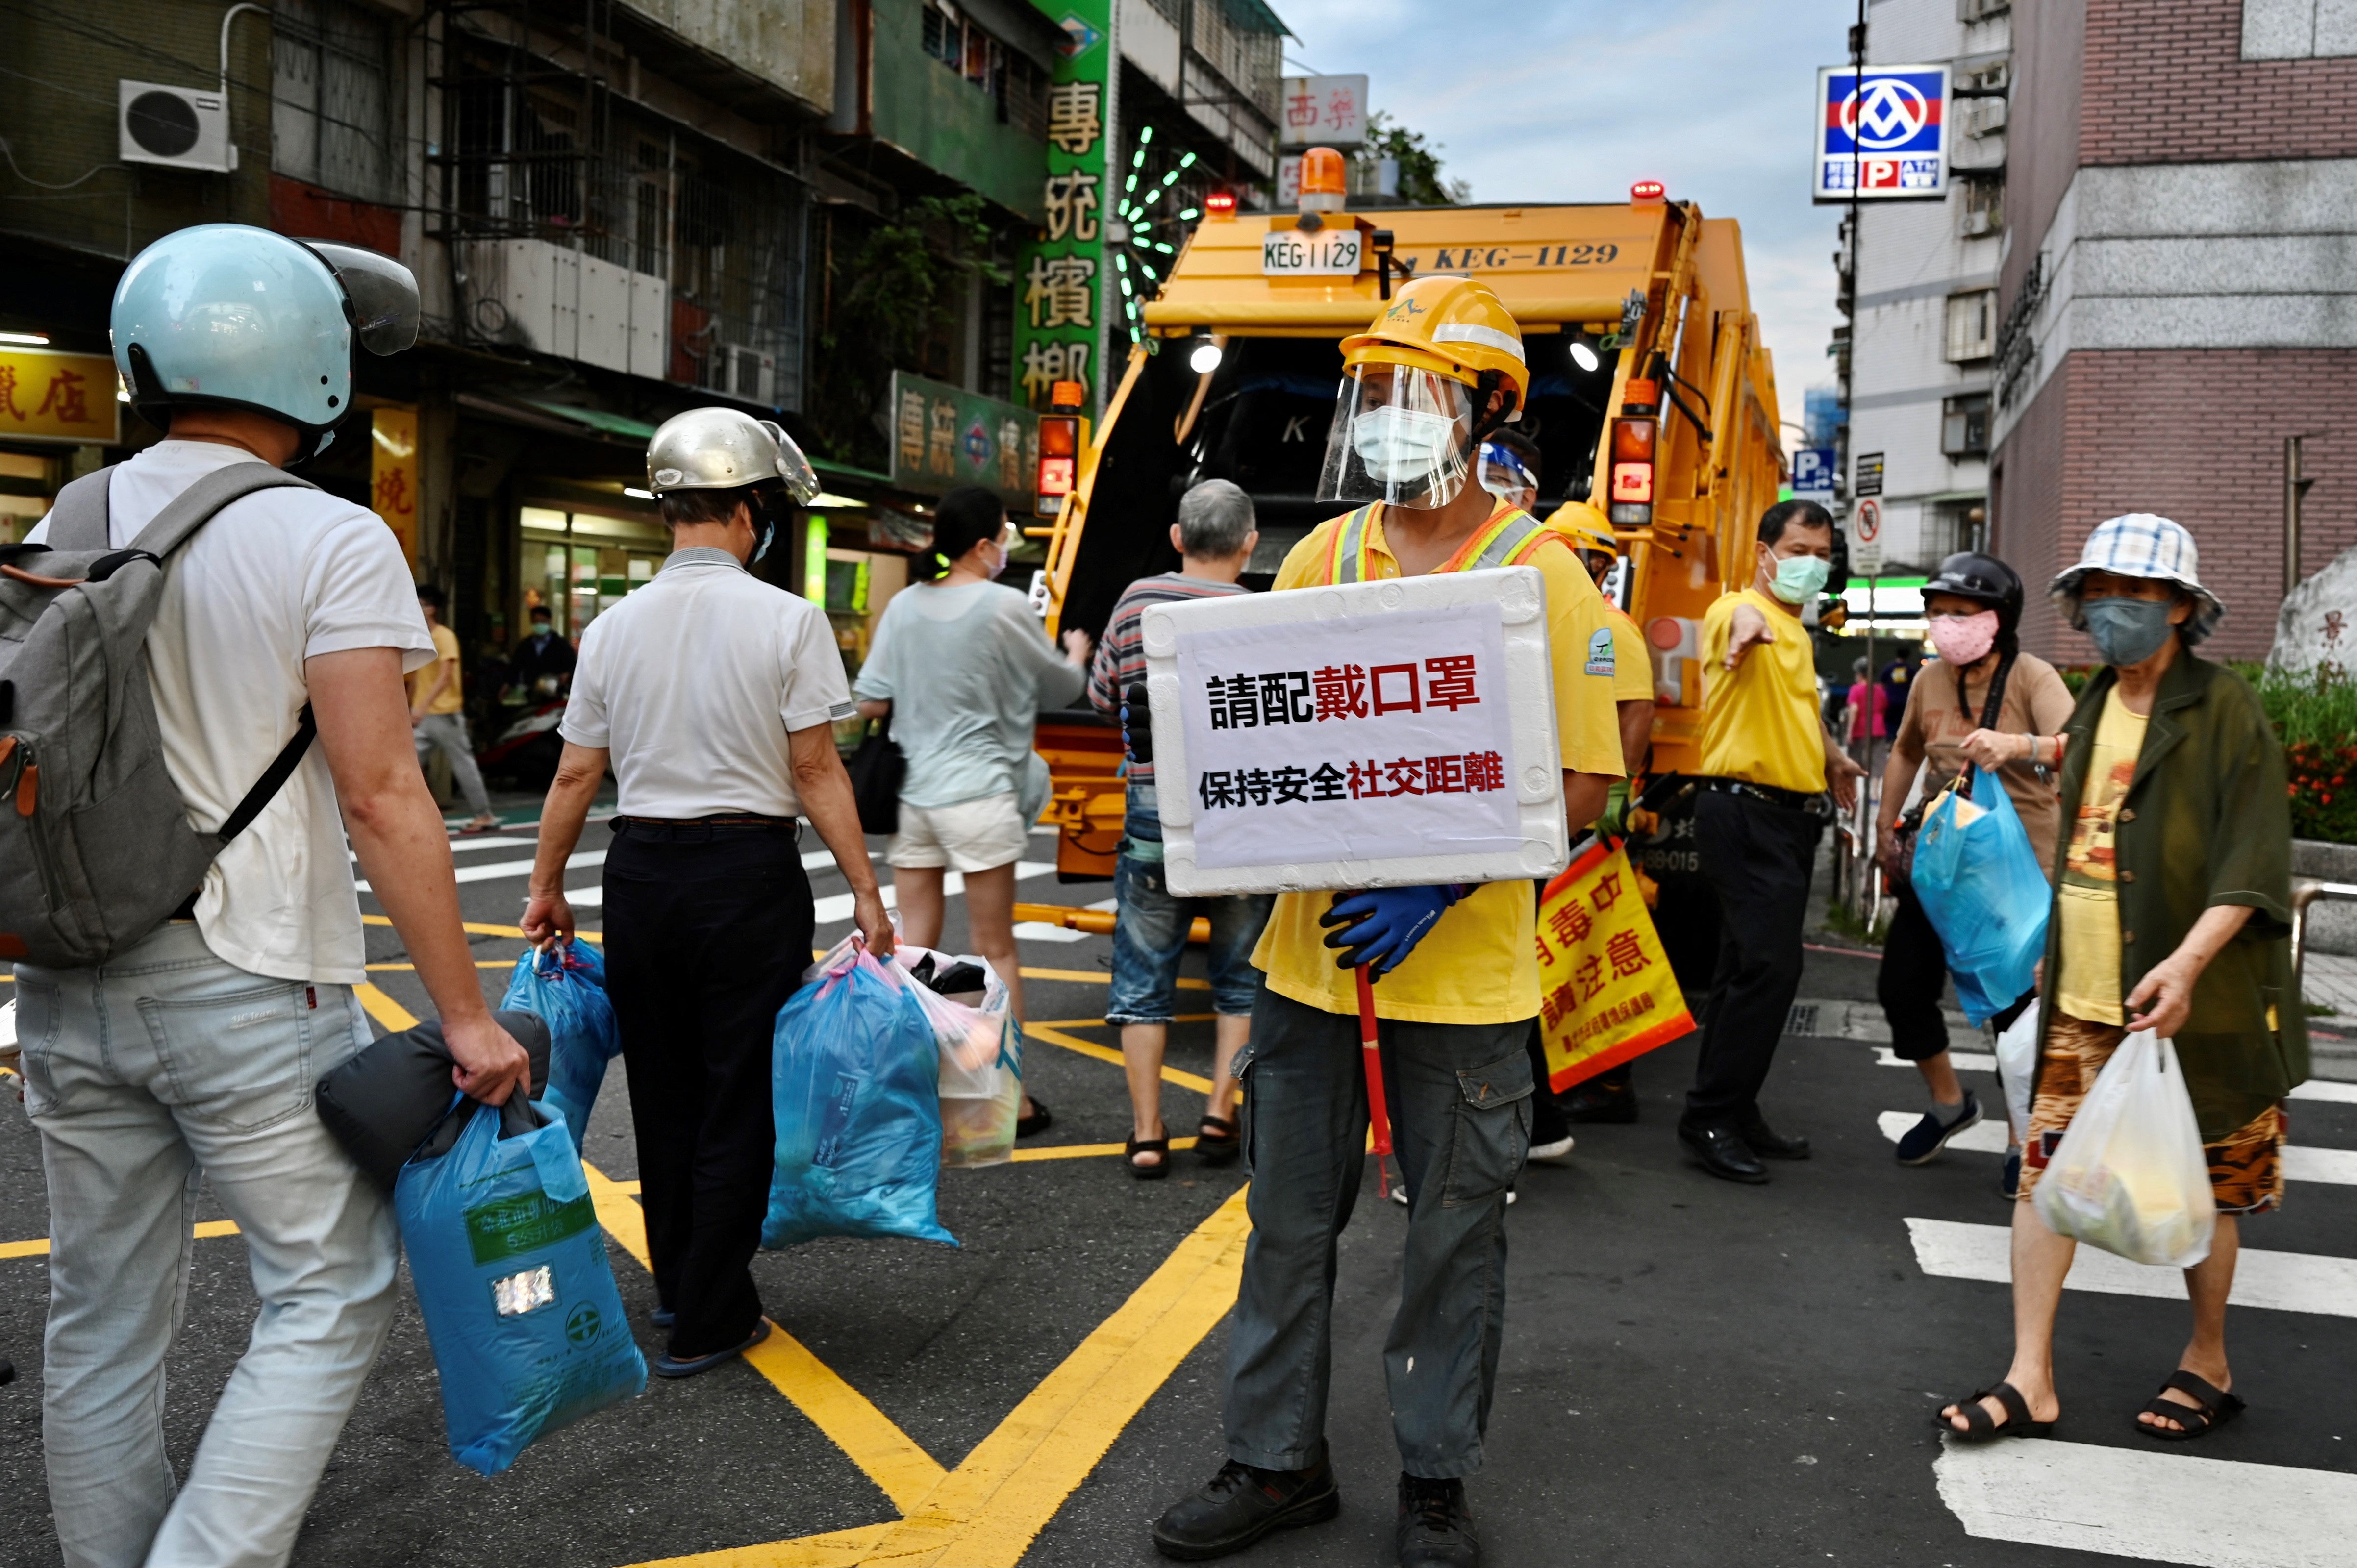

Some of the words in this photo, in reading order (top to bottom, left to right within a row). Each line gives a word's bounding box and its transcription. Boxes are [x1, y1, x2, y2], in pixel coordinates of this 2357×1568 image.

[1867, 161, 1894, 187] P
[1264, 242, 1358, 269] KEG-1129
[1434, 244, 1619, 269] KEG-1129
[1797, 452, 1821, 480] P
[1206, 654, 1480, 730] 請配戴口罩
[1199, 750, 1505, 810] 保持安全社交距離
[1541, 928, 1652, 1032] 請注意
